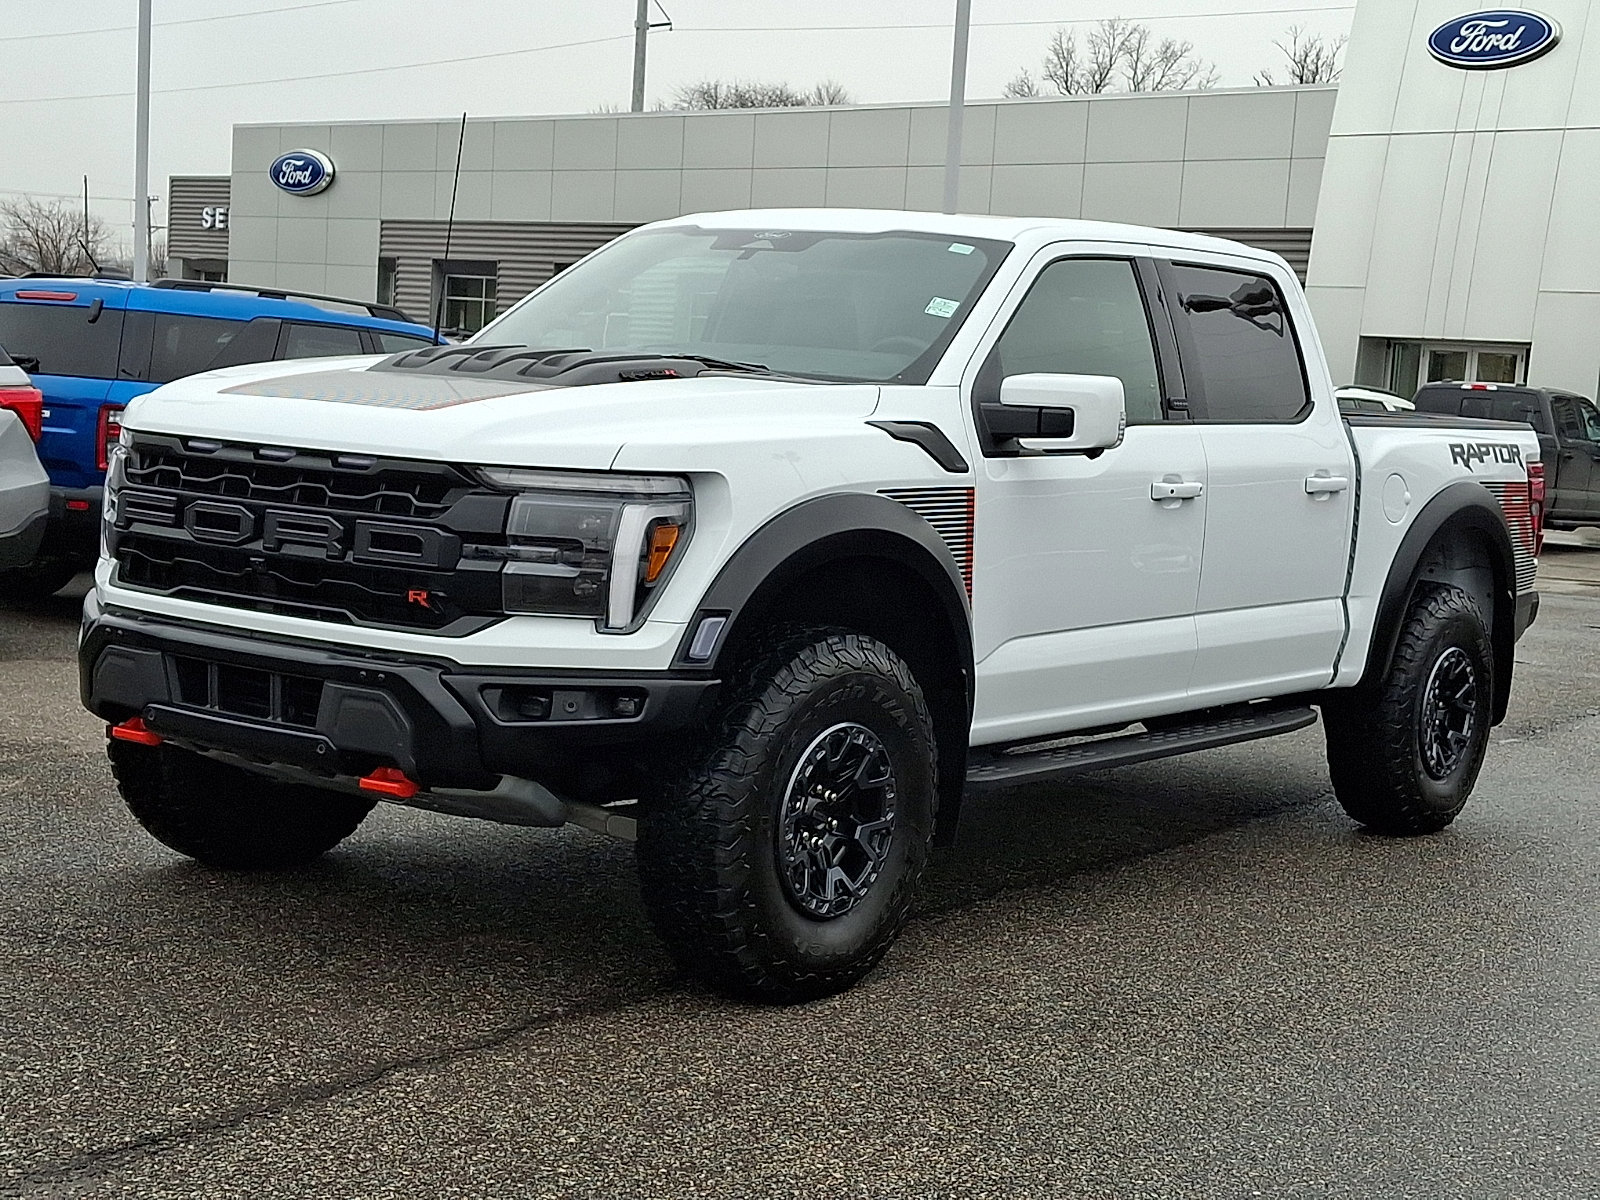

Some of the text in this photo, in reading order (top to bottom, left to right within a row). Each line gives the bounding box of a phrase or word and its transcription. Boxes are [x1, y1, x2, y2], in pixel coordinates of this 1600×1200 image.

[1450, 19, 1526, 53] Ford
[279, 159, 313, 184] Ford
[202, 207, 230, 228] SE
[1449, 443, 1526, 473] RAPTOR
[114, 489, 461, 569] FORD
